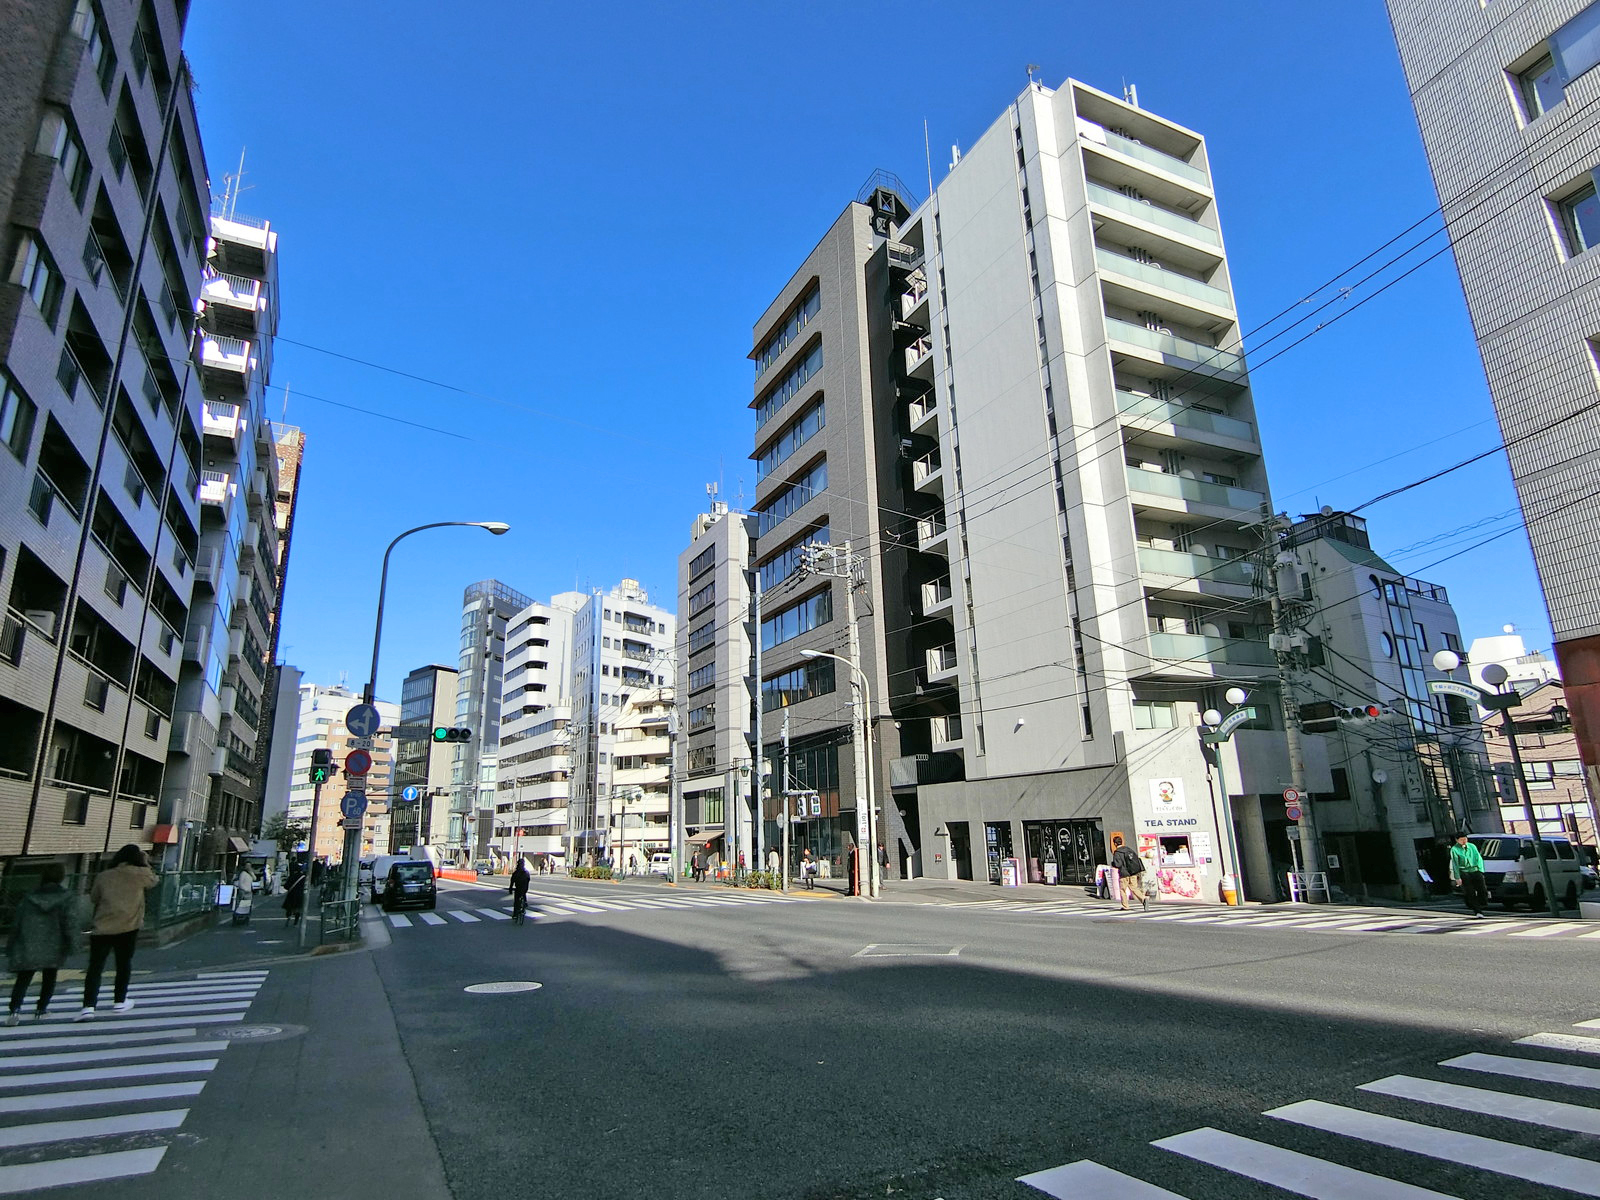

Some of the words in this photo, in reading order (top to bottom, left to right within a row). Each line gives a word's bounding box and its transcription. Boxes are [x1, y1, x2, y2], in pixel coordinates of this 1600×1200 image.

[345, 797, 357, 815] P
[1144, 819, 1164, 827] TEA
[1166, 818, 1198, 827] STAND
